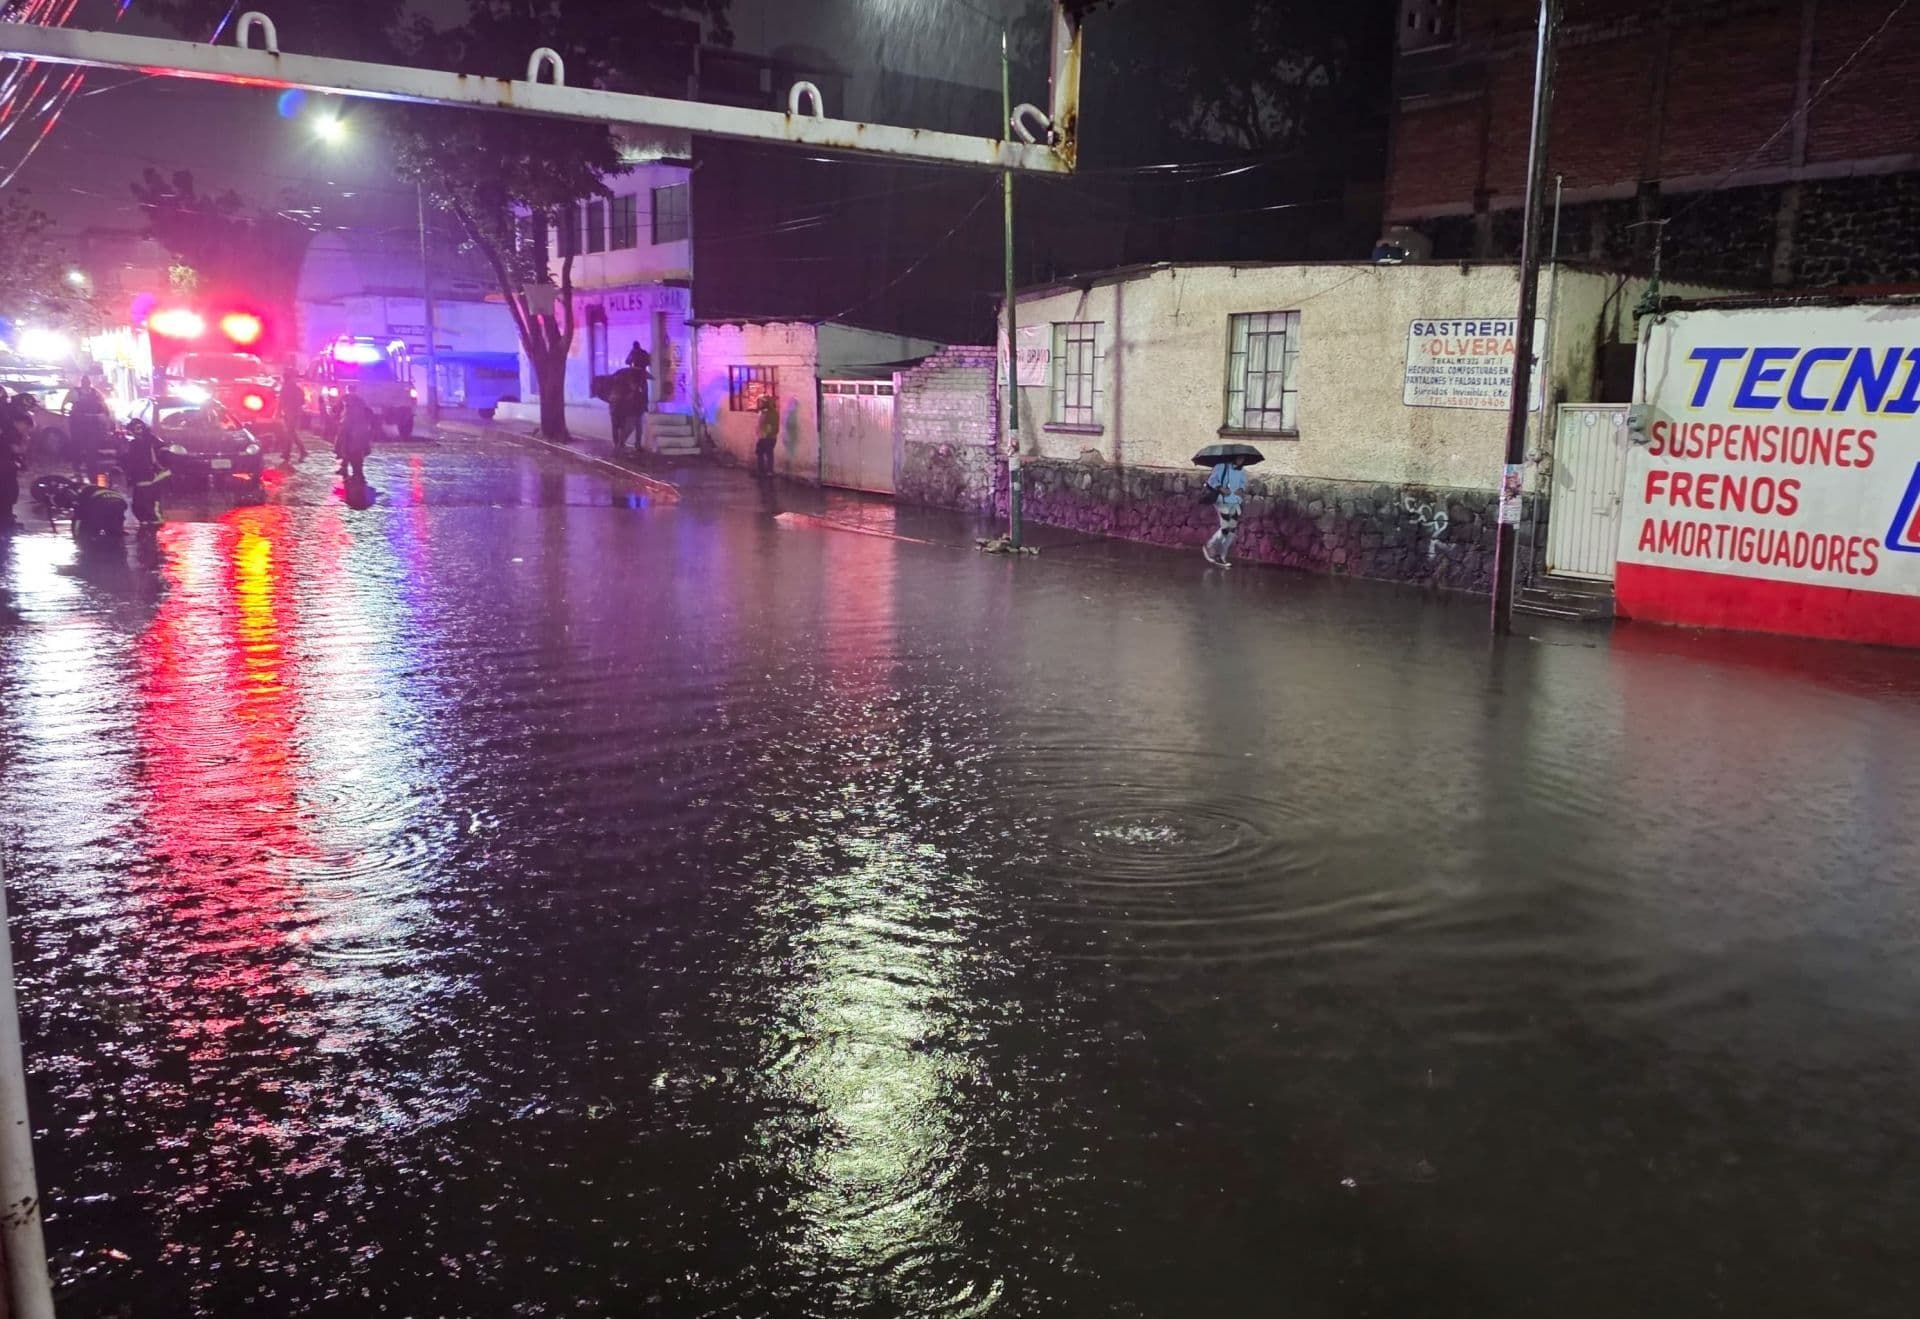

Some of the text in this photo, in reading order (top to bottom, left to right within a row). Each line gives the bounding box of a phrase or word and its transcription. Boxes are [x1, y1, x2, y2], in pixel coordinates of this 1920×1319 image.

[1413, 322, 1514, 336] SASTRERI
[1430, 338, 1516, 356] OLVERA
[1649, 421, 1878, 469] SUSPENSIONES
[1645, 470, 1802, 516] FRENOS
[1638, 518, 1881, 577] AMORTIGUADORES
